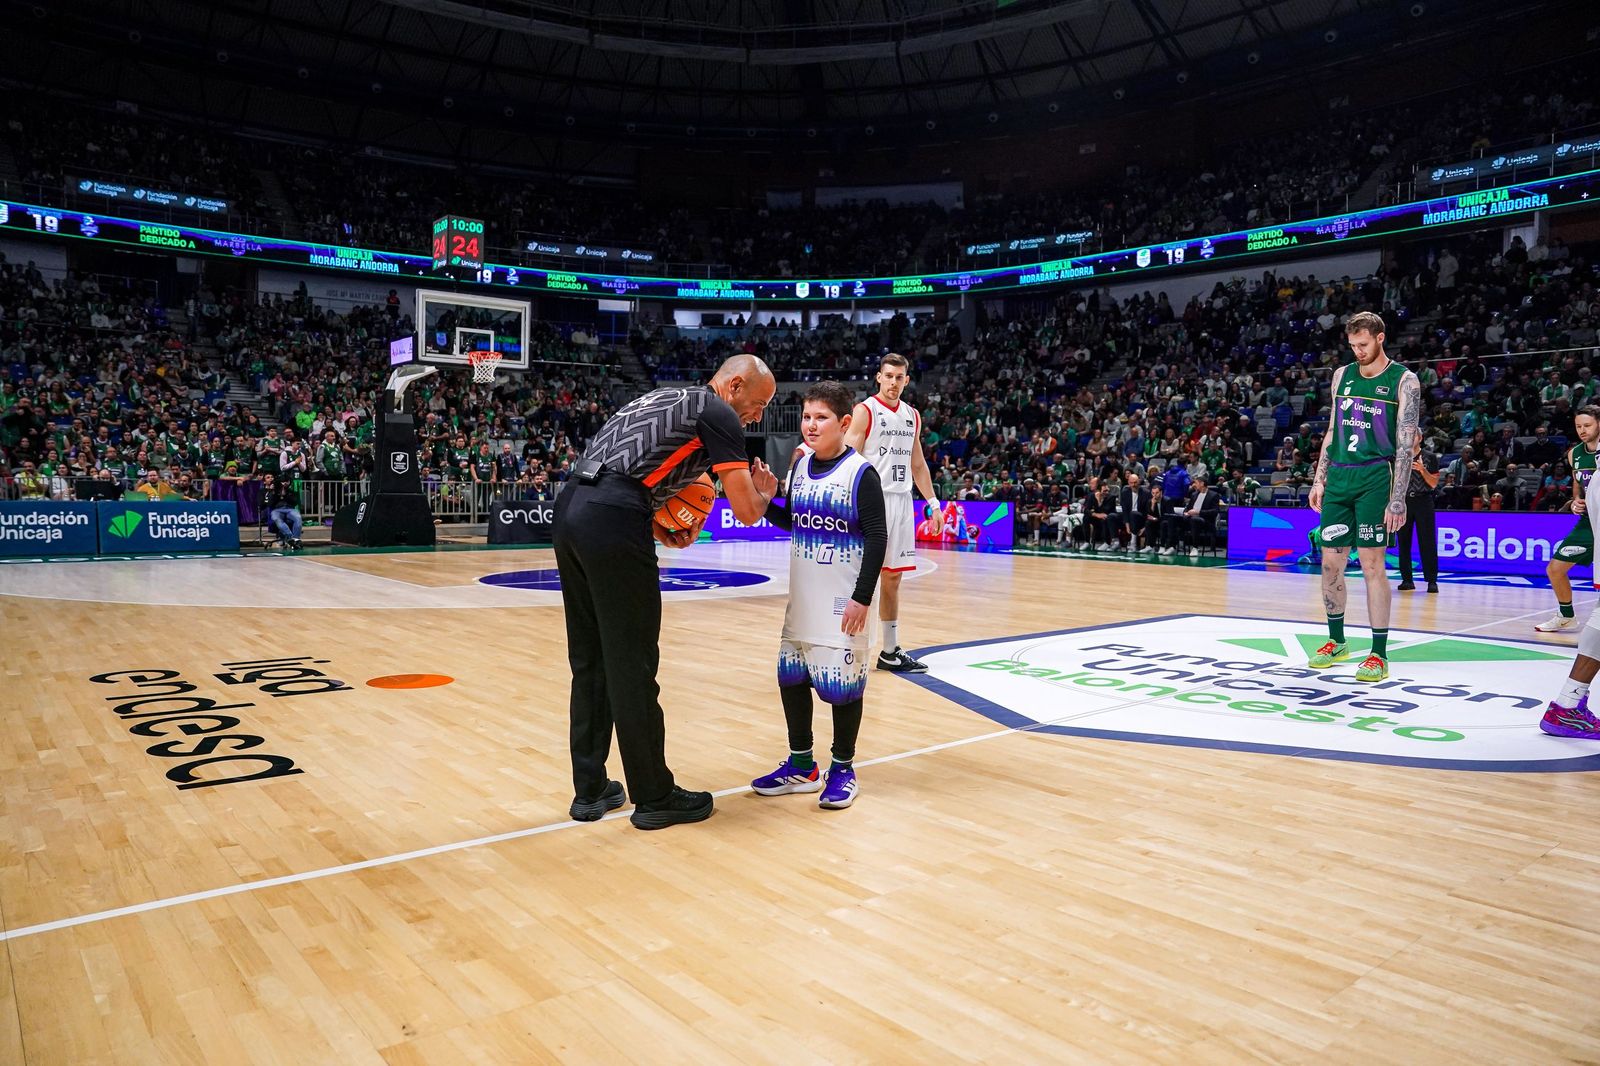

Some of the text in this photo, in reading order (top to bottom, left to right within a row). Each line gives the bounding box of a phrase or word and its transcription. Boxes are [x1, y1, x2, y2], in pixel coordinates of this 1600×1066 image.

[1572, 140, 1600, 153] Unicaj
[1507, 153, 1539, 168] Unicaja
[1445, 166, 1475, 179] Unicaja
[94, 182, 126, 193] Fundación
[94, 187, 118, 198] Unicaja
[147, 190, 178, 201] Fundación
[147, 195, 170, 205] Unicaja
[1458, 189, 1510, 208] UNICAJA
[198, 198, 227, 208] Fundación
[198, 203, 219, 213] Unicaja
[1422, 193, 1549, 226] MORABANC ANDORRA
[32, 213, 58, 233] 19
[433, 218, 448, 235] 10:00
[451, 218, 484, 234] 10:00
[1315, 221, 1367, 235] MARBELLA
[140, 225, 181, 238] PARTIDO
[1247, 229, 1283, 242] PARTIDO
[140, 234, 196, 249] DEDICADO A
[214, 239, 263, 252] MARBELLA
[433, 235, 447, 259] 24
[452, 235, 480, 258] 24
[1247, 236, 1298, 251] DEDICADO A
[337, 248, 374, 261] UNICAJA
[538, 244, 560, 254] Unicaja
[586, 248, 607, 258] Unicaja
[631, 252, 653, 262] Unicaja
[1166, 248, 1185, 265] 19
[309, 254, 399, 273] MORABANC ANDORRA
[461, 259, 481, 269] Unicaja
[1041, 260, 1072, 273] UNICAJA
[476, 269, 492, 284] 19
[547, 273, 577, 283] PARTIDO
[1019, 265, 1094, 285] MORABANC ANDORRA
[547, 280, 589, 291] DEDICADO A
[700, 281, 732, 290] UNICAJA
[893, 279, 922, 287] PARTIDO
[893, 284, 934, 294] DEDICADO A
[677, 288, 755, 298] MORABANC ANDORRA
[823, 285, 840, 298] 19
[1354, 403, 1383, 416] Unicaja
[1342, 417, 1372, 430] málaga
[1347, 434, 1360, 452] 2
[889, 446, 911, 456] Andor
[892, 464, 907, 482] 13
[148, 511, 231, 525] Fundación
[499, 504, 554, 524] ende
[149, 525, 210, 541] Unicaja
[1437, 527, 1563, 562] Balon
[816, 543, 835, 564] 6
[213, 656, 355, 698] liga
[1079, 642, 1543, 709] Fundación
[1088, 658, 1420, 714] Unicaja
[964, 659, 1466, 743] Baloncesto
[88, 669, 306, 791] endesa
